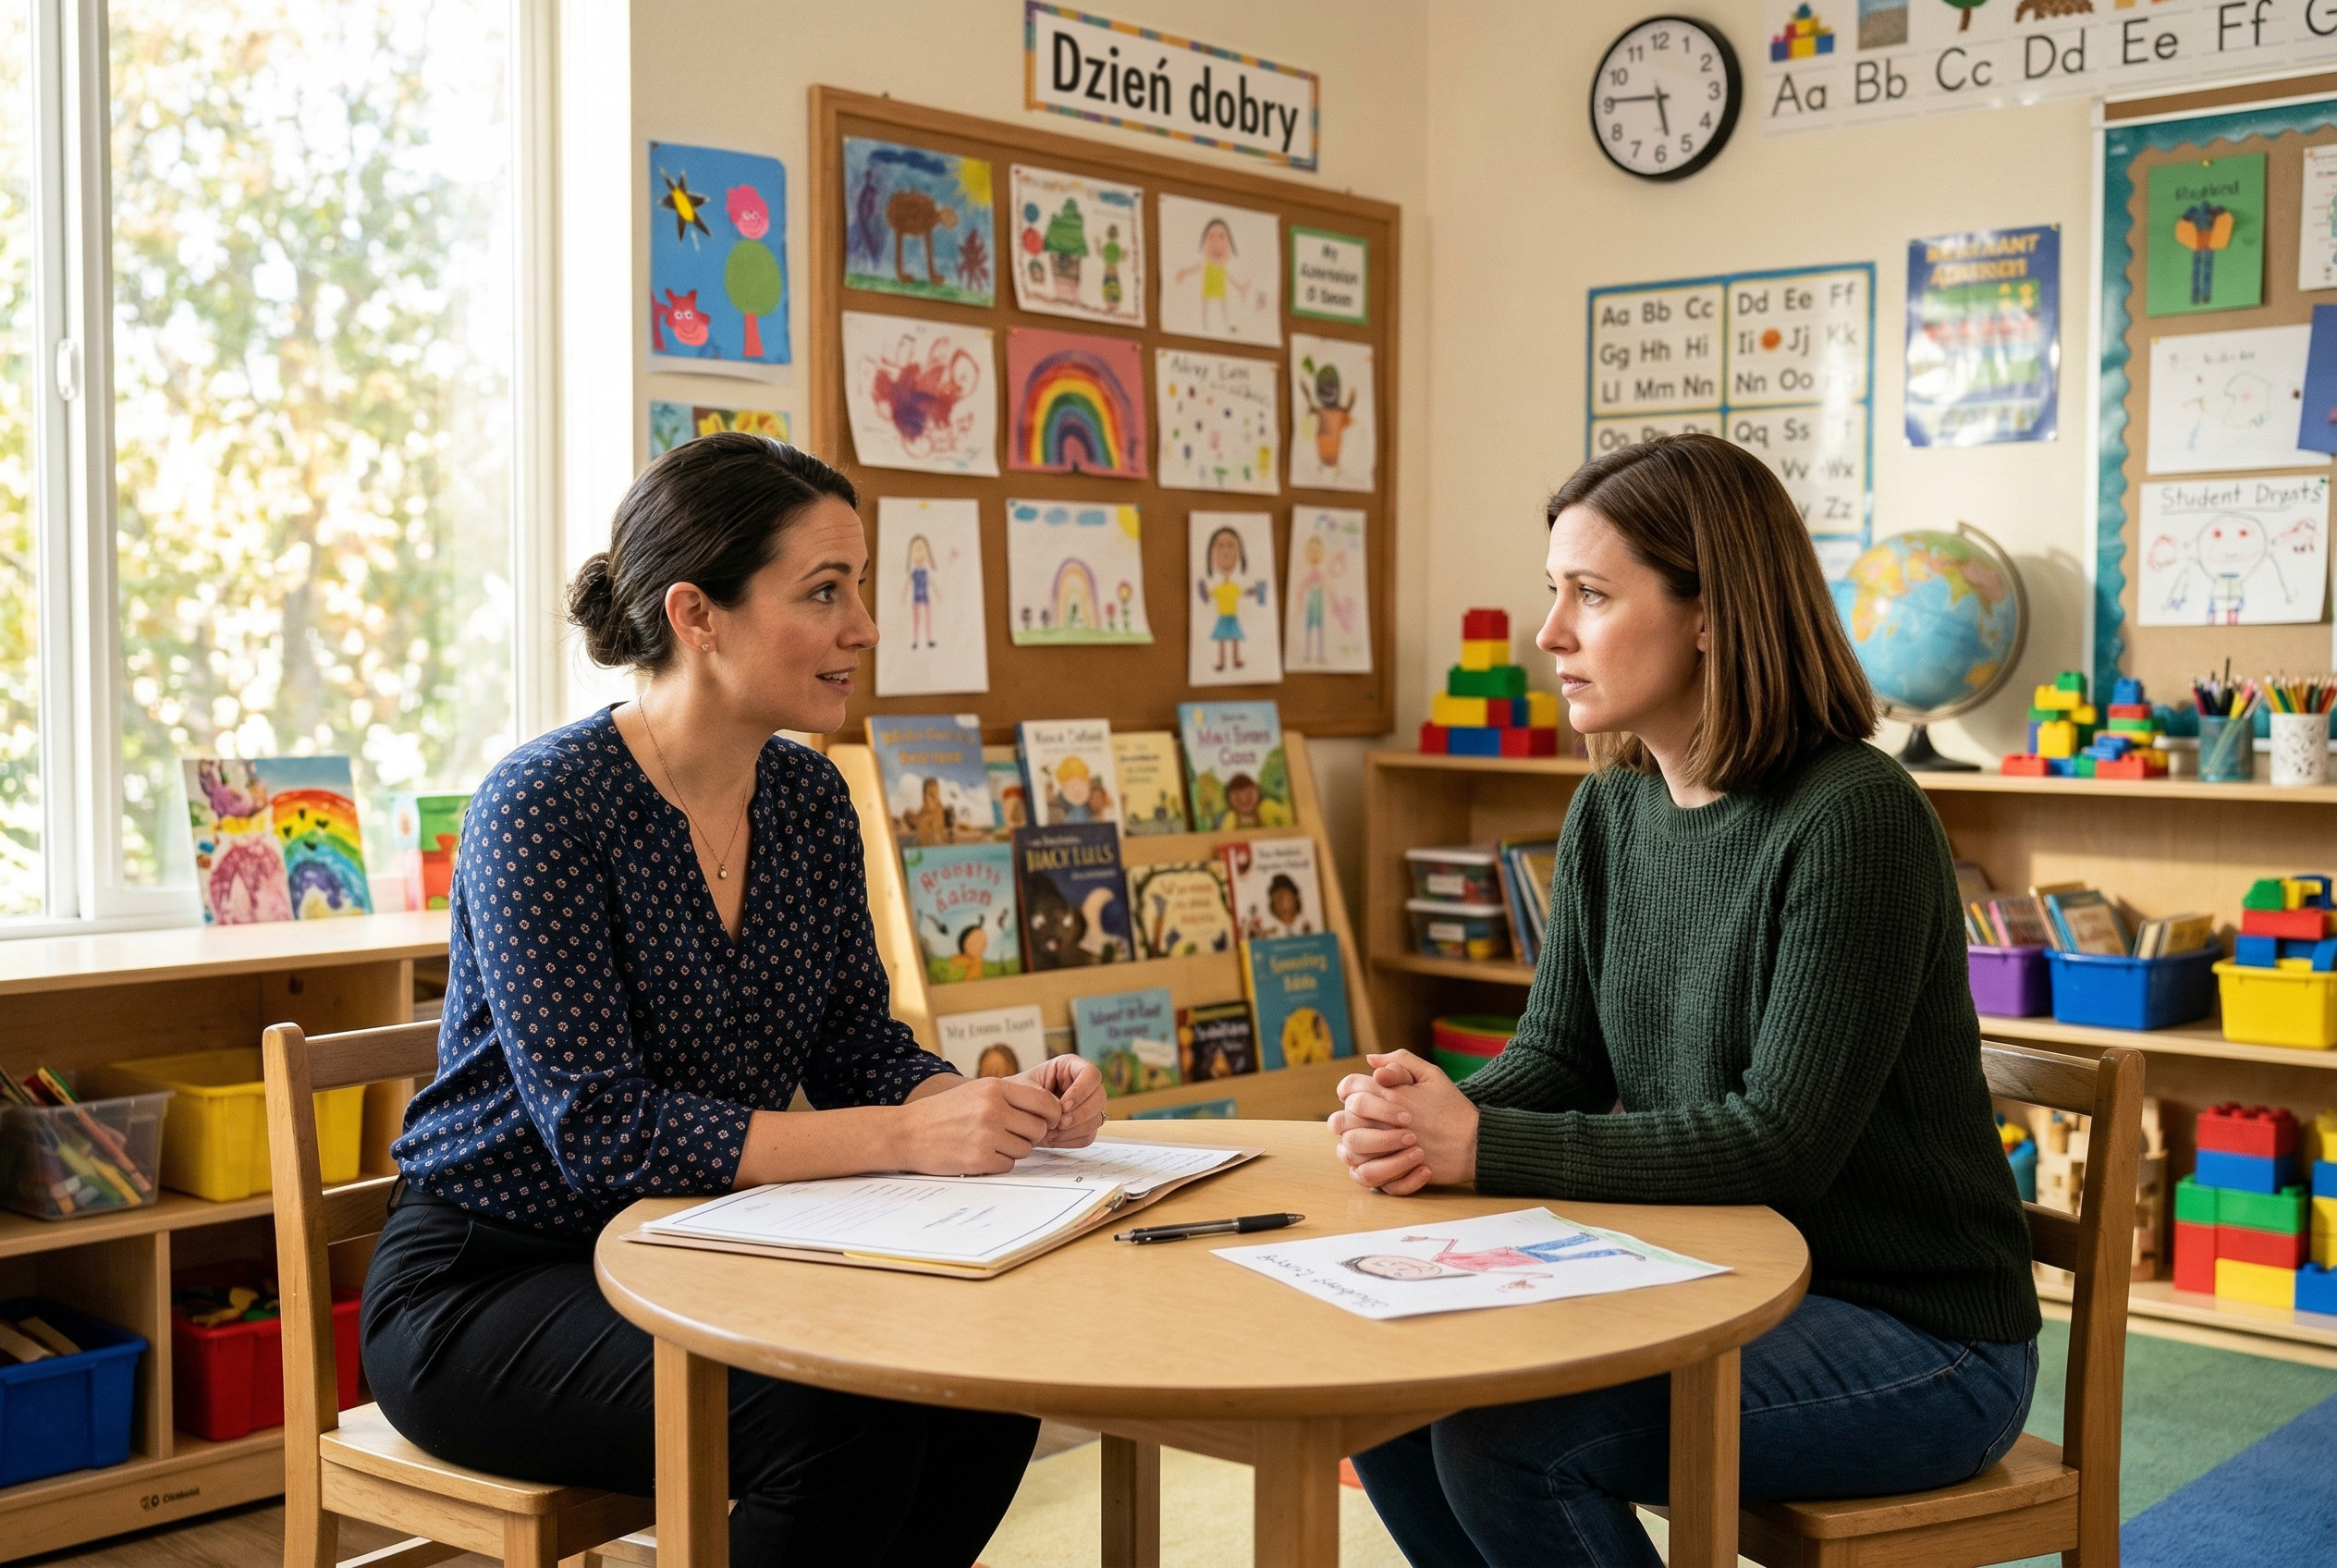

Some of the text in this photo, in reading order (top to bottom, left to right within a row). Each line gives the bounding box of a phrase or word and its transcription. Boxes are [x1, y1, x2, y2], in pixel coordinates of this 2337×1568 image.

[1650, 31, 1670, 51] 12
[1682, 36, 1690, 54] 1
[1628, 45, 1644, 62] 11
[1700, 54, 1712, 72] 2
[1771, 73, 1827, 116] Aa
[1855, 57, 1907, 104] Bb
[1936, 47, 1992, 92] Cc
[2025, 28, 2086, 79] Dd
[2123, 18, 2178, 65] Ee
[2218, 0, 2273, 52] Ff
[1609, 67, 1628, 86] 10
[1053, 31, 1298, 153] Dzień dobry
[1708, 81, 1720, 100] 3
[1603, 97, 1615, 114] 9
[1699, 112, 1711, 129] 4
[1611, 123, 1623, 141] 8
[1630, 141, 1642, 158] 7
[1655, 145, 1667, 163] 6
[1680, 134, 1693, 153] 5
[1738, 282, 1856, 315] Dd Ee Ff
[1601, 297, 1714, 326] Aa Bb Cc
[1738, 325, 1857, 358] Ii Jj Kk
[1599, 344, 1630, 370] Gg
[1641, 341, 1671, 362] Hh
[1633, 379, 1674, 400] Mm
[1683, 374, 1714, 398] Nn
[1735, 372, 1767, 395] Nn
[1780, 368, 1814, 391] Oo
[1598, 428, 1630, 450] Oo
[1735, 421, 1769, 448] Qq
[1783, 419, 1810, 441] Ss
[1780, 459, 1810, 480] Vv
[2160, 484, 2240, 508] Student
[1825, 496, 1853, 520] Zz
